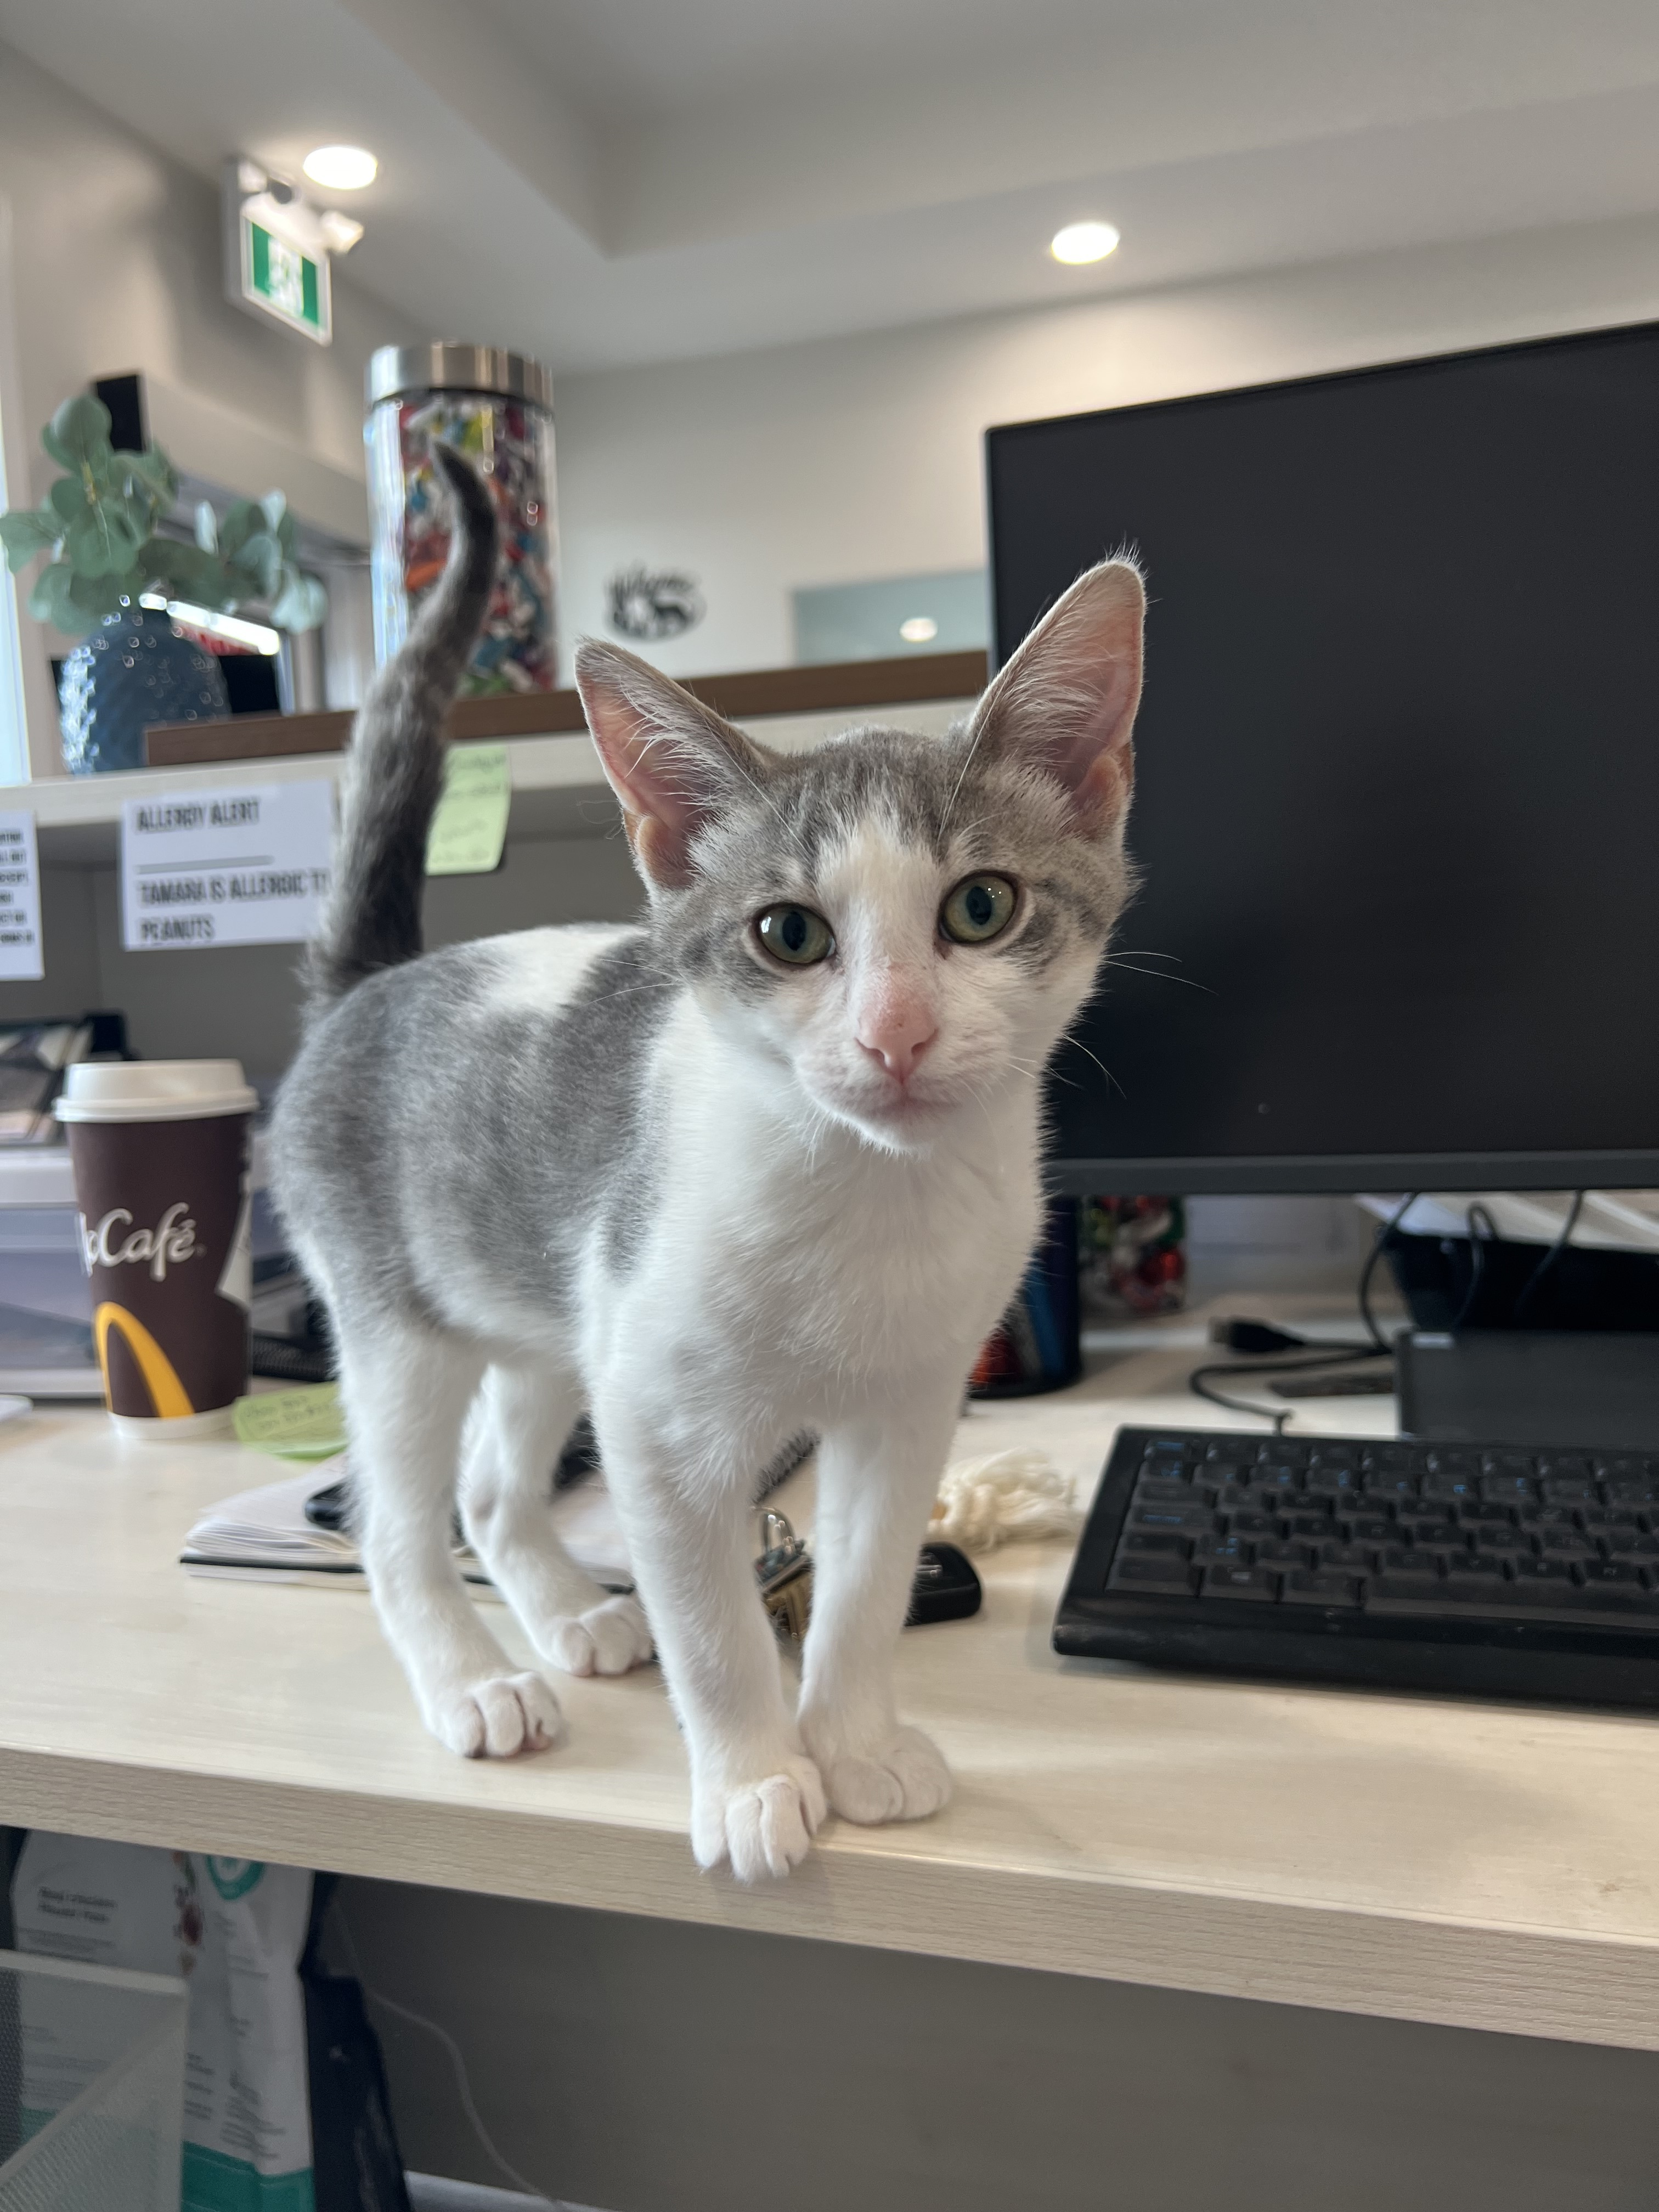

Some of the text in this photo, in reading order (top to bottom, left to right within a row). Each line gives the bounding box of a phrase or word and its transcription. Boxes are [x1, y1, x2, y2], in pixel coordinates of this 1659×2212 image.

[137, 799, 259, 832] ALLERGY ALERT
[140, 879, 206, 906] TAMARA
[209, 878, 225, 902] IS
[229, 872, 306, 900] ALLERGIC
[140, 916, 214, 942] PEANUTS
